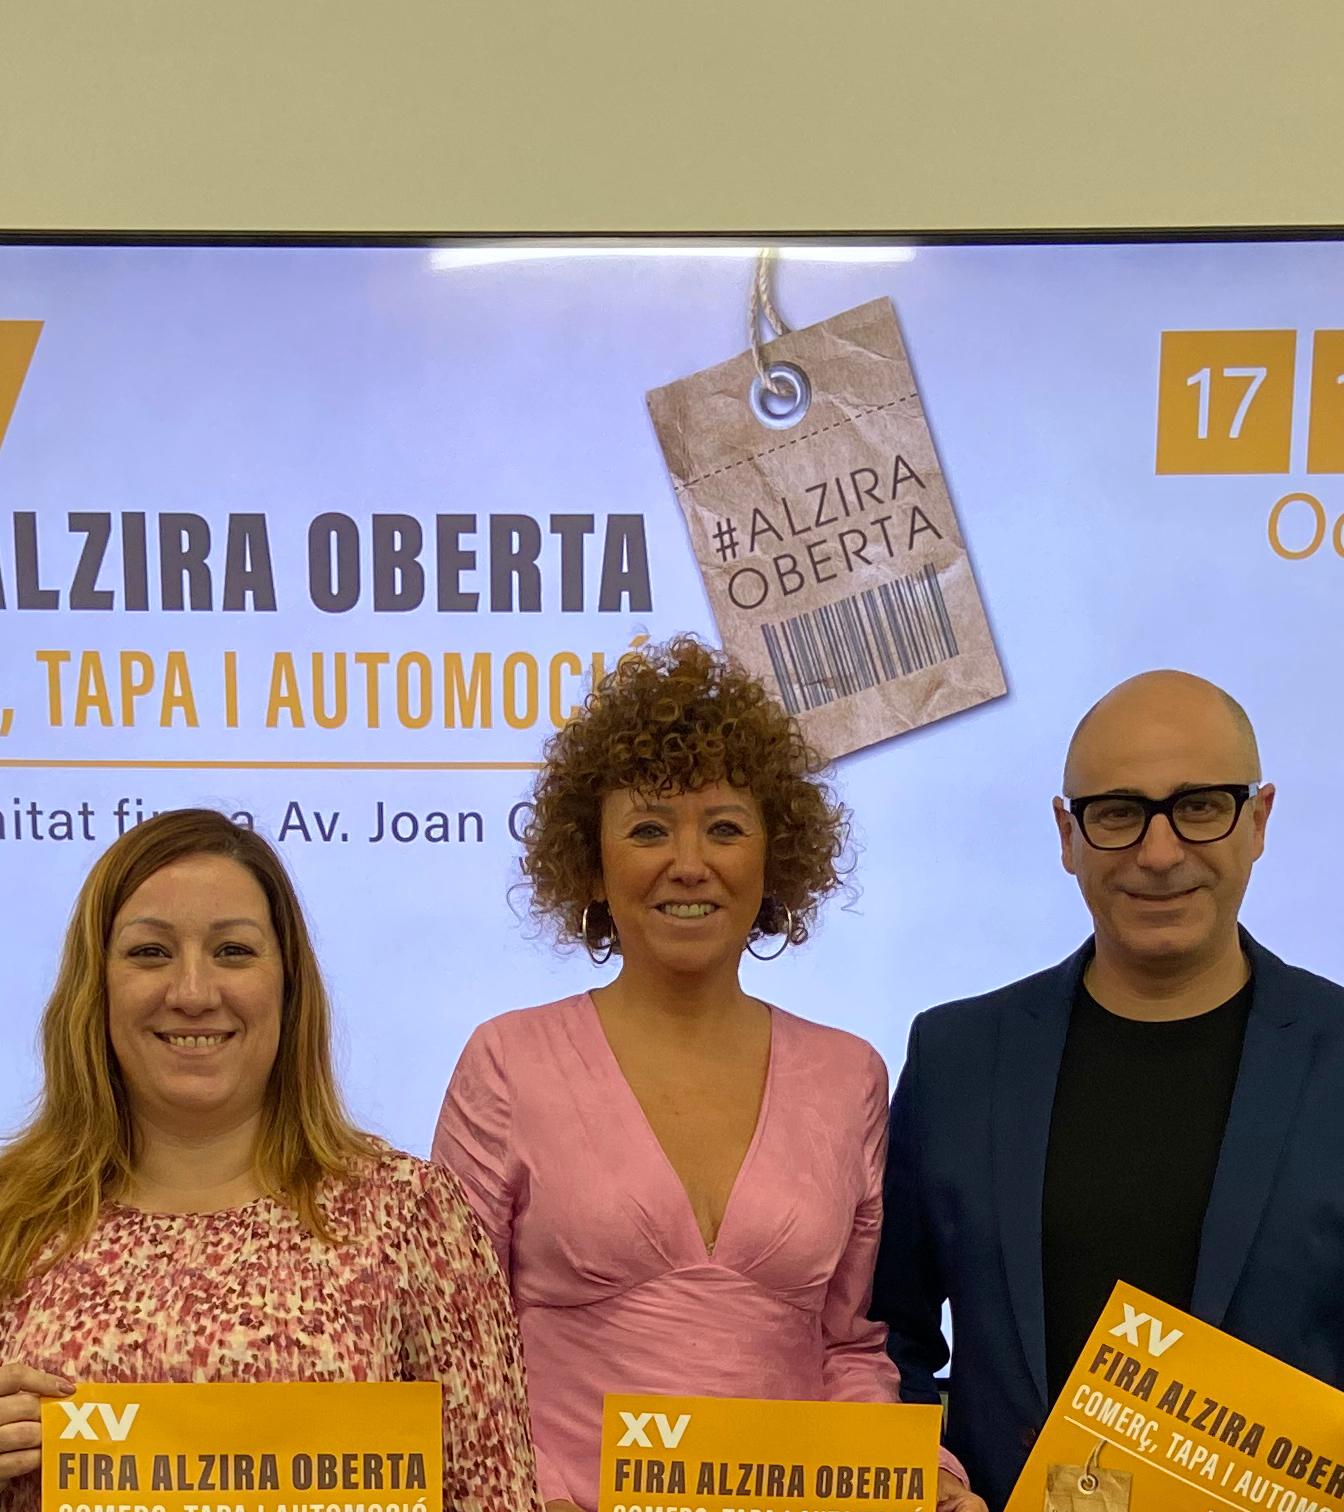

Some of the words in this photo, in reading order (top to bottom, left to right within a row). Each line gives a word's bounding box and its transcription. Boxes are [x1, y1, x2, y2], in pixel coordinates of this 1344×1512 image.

[1185, 367, 1268, 440] 17
[713, 453, 928, 565] #ALZIRA
[309, 513, 652, 613] OBERTA
[727, 507, 942, 612] OBERTA
[36, 650, 198, 729] TAPA
[223, 651, 238, 729] I
[278, 802, 350, 842] Av.
[368, 802, 484, 843] Joan
[1108, 1303, 1184, 1357] XV
[59, 1402, 140, 1440] XV
[617, 1412, 691, 1448] XV
[1071, 1384, 1161, 1453] COMERÇ,
[1165, 1432, 1217, 1480] TAPA
[1222, 1471, 1233, 1488] I
[1088, 1344, 1158, 1401] FIRA
[1156, 1381, 1266, 1459] ALZIRA
[58, 1453, 140, 1491] FIRA
[151, 1454, 280, 1491] ALZIRA
[292, 1453, 426, 1490] OBERTA
[614, 1459, 686, 1494] FIRA
[696, 1462, 804, 1497] ALZIRA
[815, 1466, 924, 1500] OBERTA
